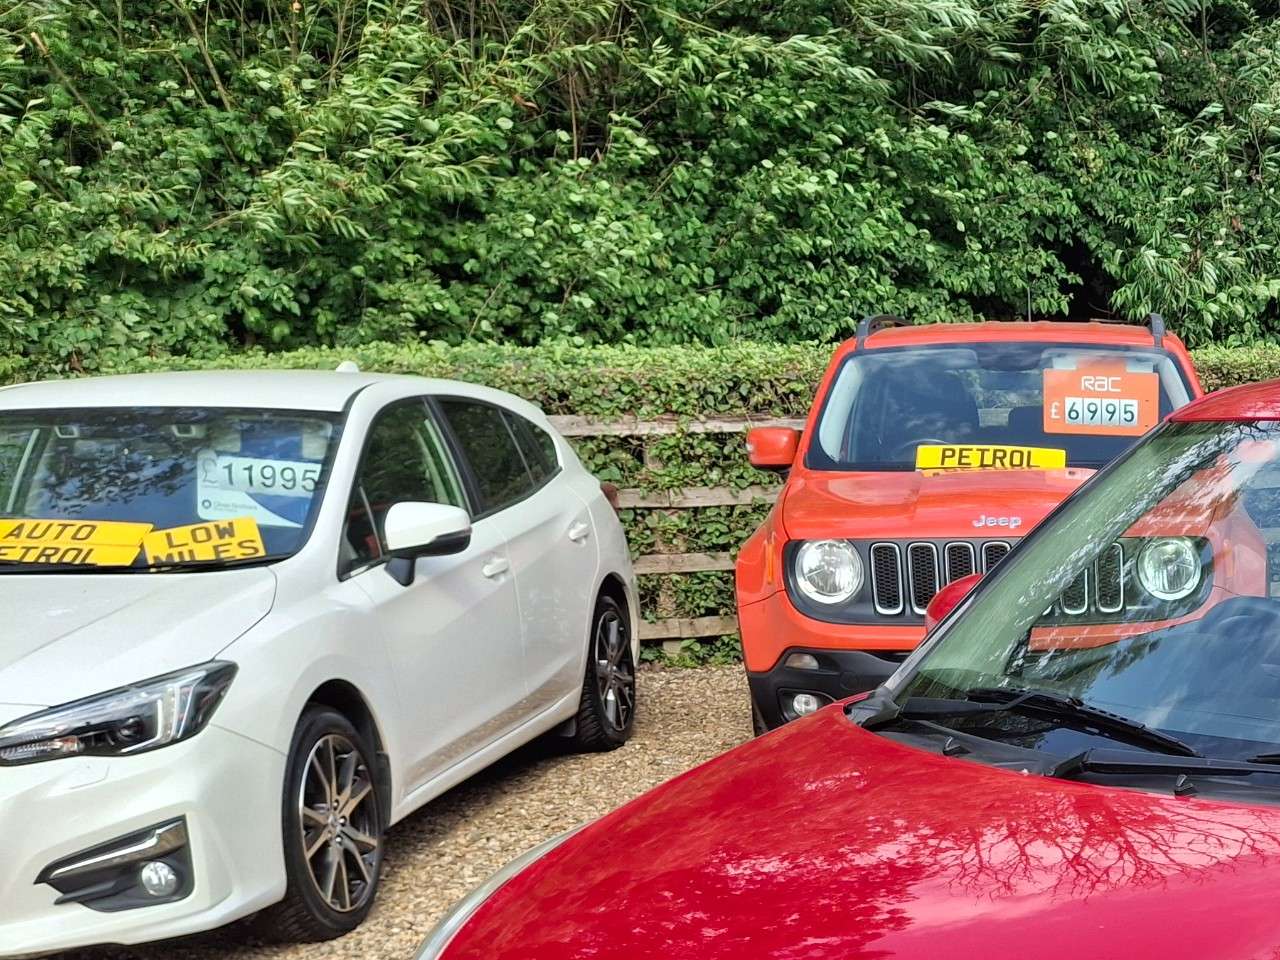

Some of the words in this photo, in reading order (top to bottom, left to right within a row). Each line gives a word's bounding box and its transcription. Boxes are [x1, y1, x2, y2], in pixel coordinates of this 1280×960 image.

[940, 447, 1041, 468] PETROL
[2, 522, 97, 541] AUTO
[972, 514, 1022, 529] Jeep
[165, 521, 236, 549] LOW
